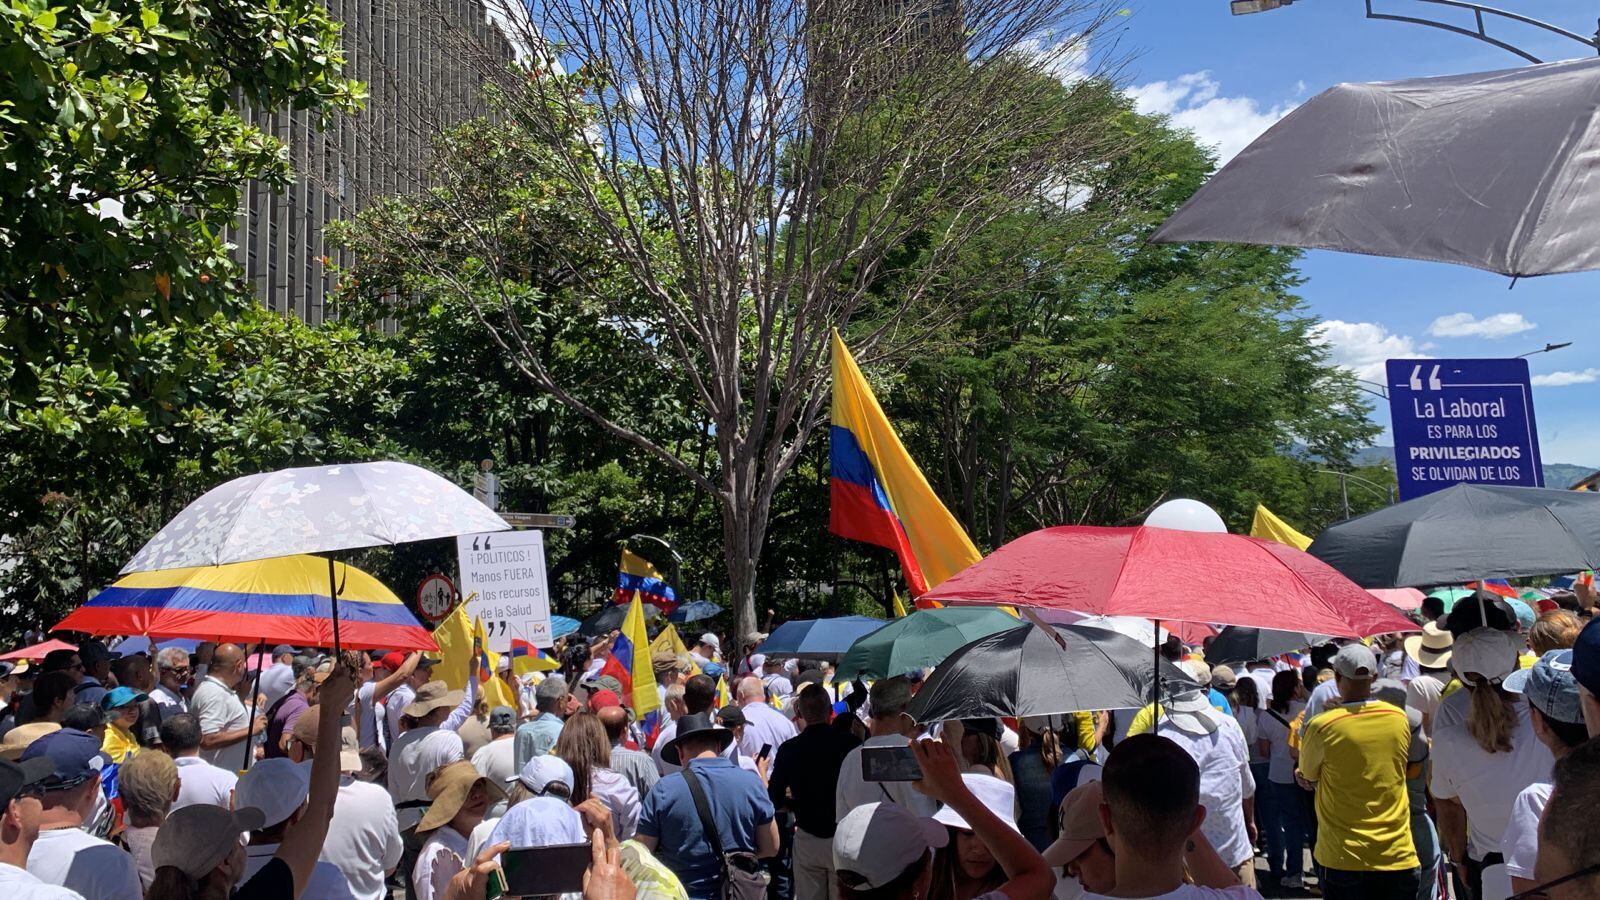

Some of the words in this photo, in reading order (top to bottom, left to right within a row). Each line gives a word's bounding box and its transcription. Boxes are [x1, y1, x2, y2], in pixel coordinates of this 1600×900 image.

[1414, 397, 1435, 418] La
[1440, 397, 1505, 418] Laboral
[1427, 425, 1441, 439] ES
[1445, 425, 1474, 438] PARA
[1476, 424, 1498, 438] LOS
[1410, 446, 1521, 460] PRIVILEGIADOS
[1412, 467, 1427, 481] SE
[1430, 466, 1477, 480] OLVIDAN
[1480, 466, 1496, 480] DE
[1499, 466, 1520, 480] LOS
[471, 571, 502, 583] Manos
[504, 567, 534, 581] FUERA
[482, 589, 497, 601] los
[499, 587, 540, 599] recursos
[480, 607, 492, 619] de
[495, 606, 503, 618] la
[506, 603, 532, 617] Salud
